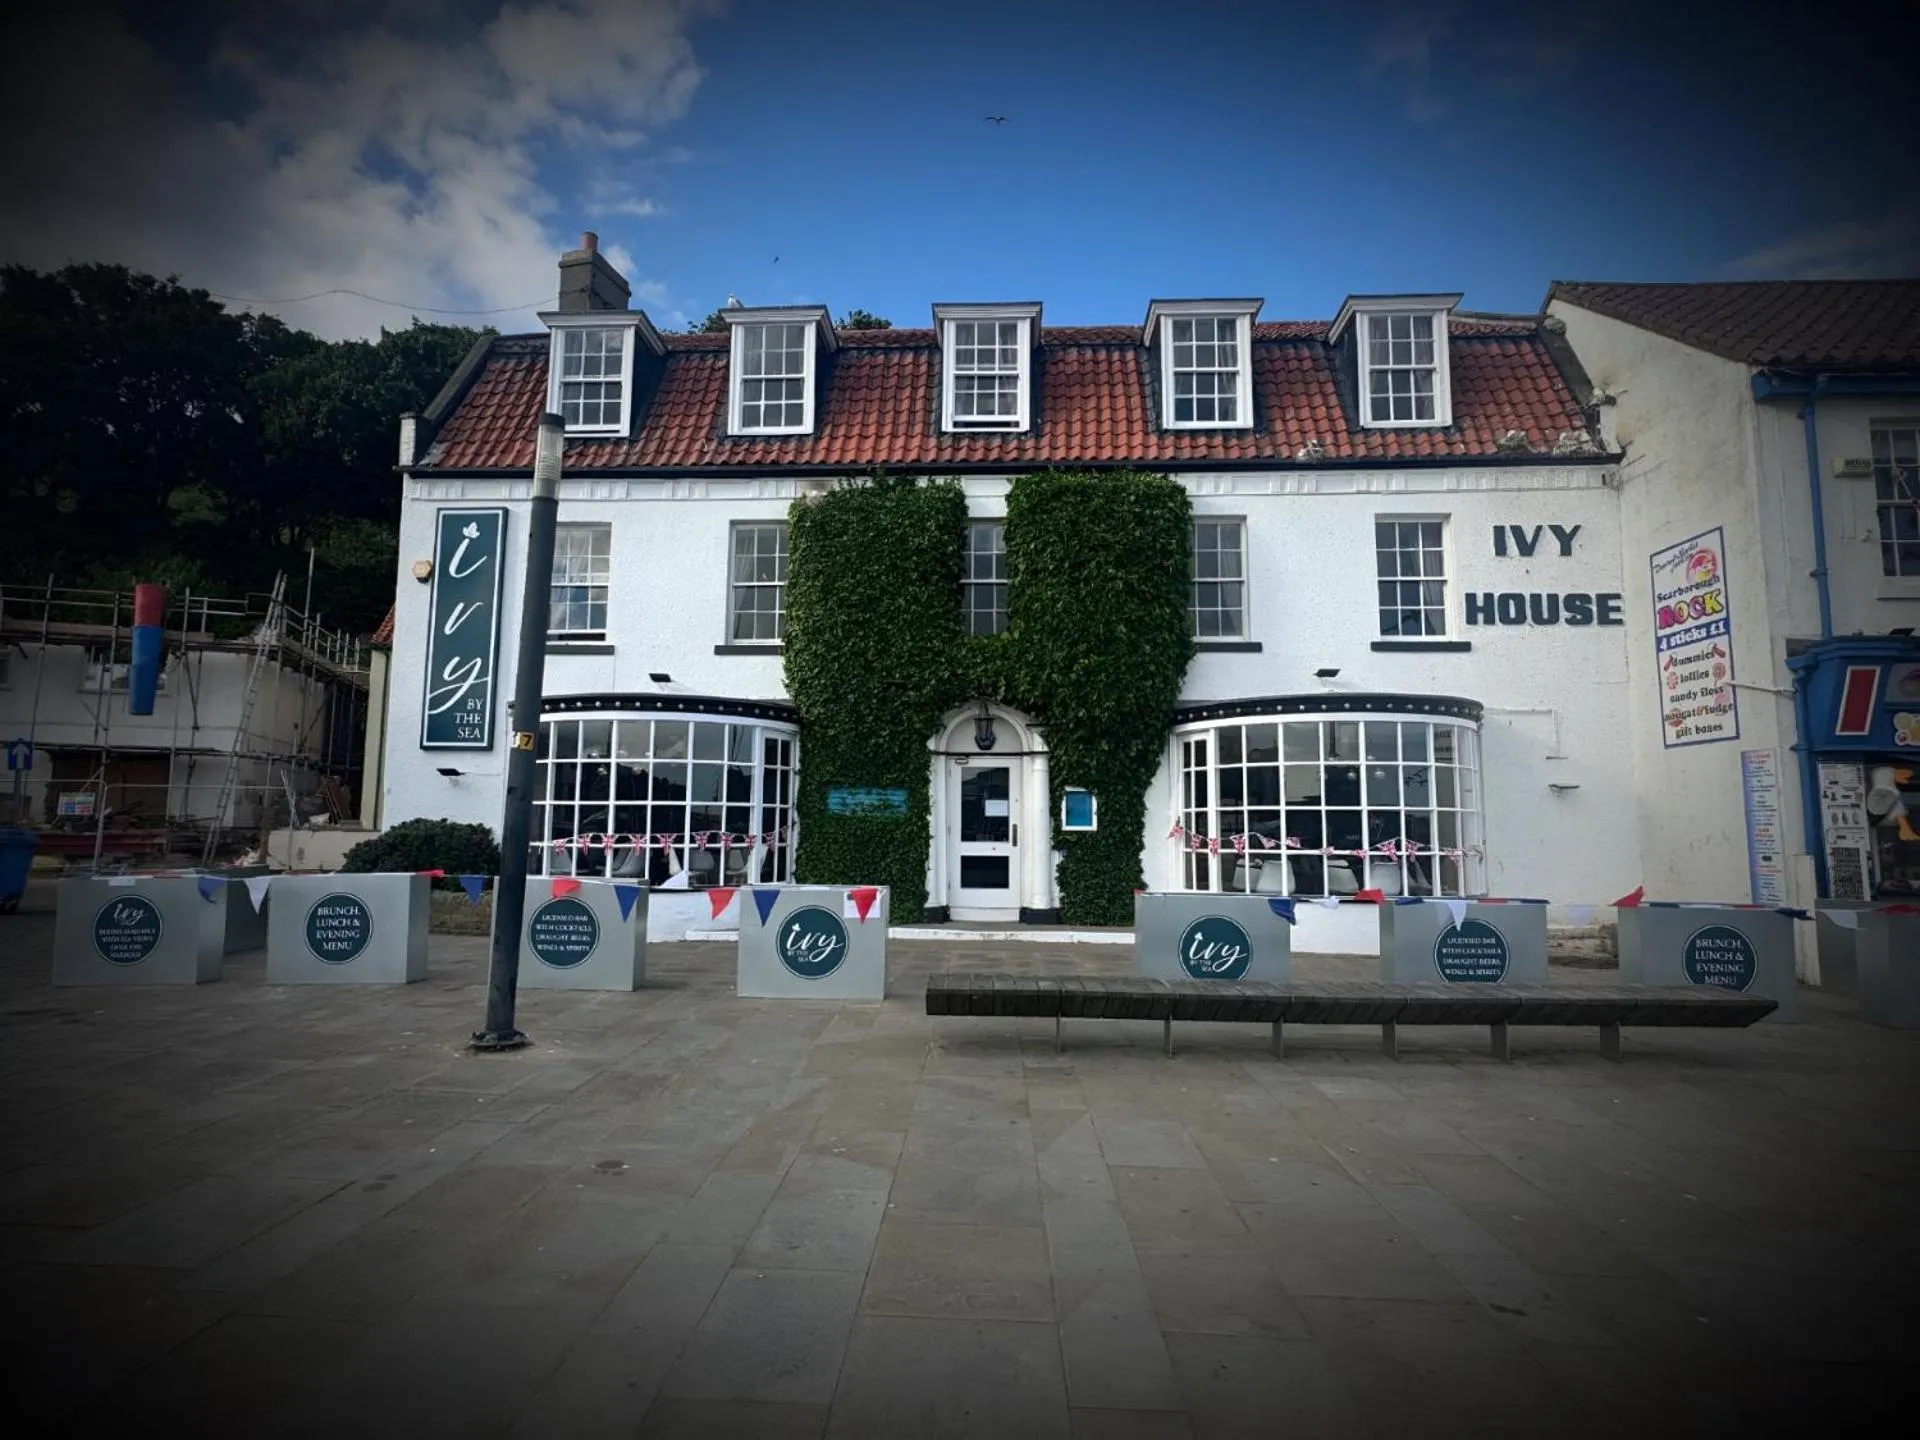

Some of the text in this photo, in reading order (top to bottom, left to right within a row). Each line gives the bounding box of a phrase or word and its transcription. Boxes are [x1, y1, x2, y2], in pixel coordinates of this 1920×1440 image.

[1493, 524, 1581, 557] IVY
[1657, 574, 1720, 603] Scarborough
[1465, 592, 1624, 625] HOUSE
[1658, 588, 1724, 630] ROCK
[1660, 620, 1726, 650] 4 sticks £1
[1672, 650, 1715, 667] dummies
[1680, 670, 1710, 683] lollies
[1670, 686, 1724, 704] candy floss
[467, 699, 483, 710] BY
[454, 712, 482, 724] THE
[457, 727, 481, 739] SEA
[1676, 723, 1723, 739] gift boxes
[316, 918, 361, 928] LUNCH &
[316, 929, 360, 939] EVENING
[323, 941, 352, 950] MENU
[786, 922, 845, 962] ivy
[1189, 931, 1248, 972] ivy
[1695, 950, 1744, 961] LUNCH &
[1696, 963, 1744, 973] EVENING
[1705, 975, 1737, 985] MENU
